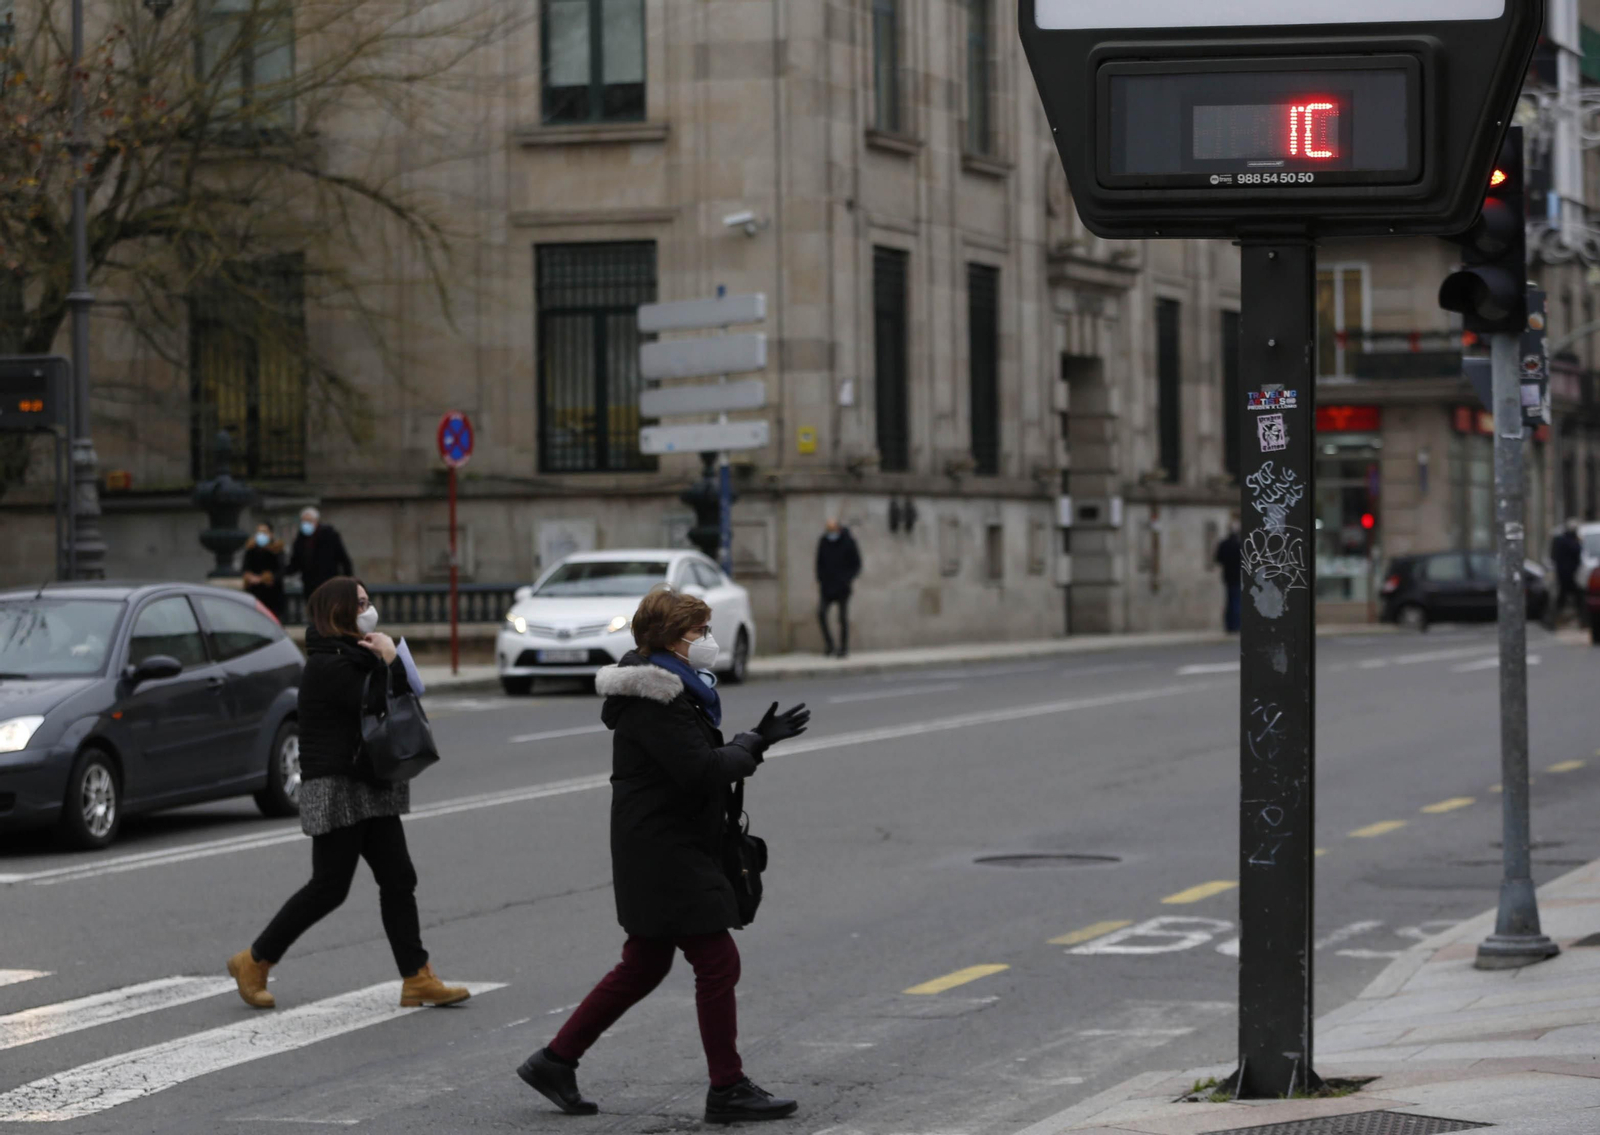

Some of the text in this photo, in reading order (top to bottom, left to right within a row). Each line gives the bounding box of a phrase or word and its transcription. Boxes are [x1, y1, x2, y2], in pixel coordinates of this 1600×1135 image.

[1237, 172, 1315, 184] 988 54 50 50
[1247, 390, 1297, 399] TRAVELING
[1248, 397, 1286, 406] ARTISTS
[1245, 460, 1276, 496] STOP
